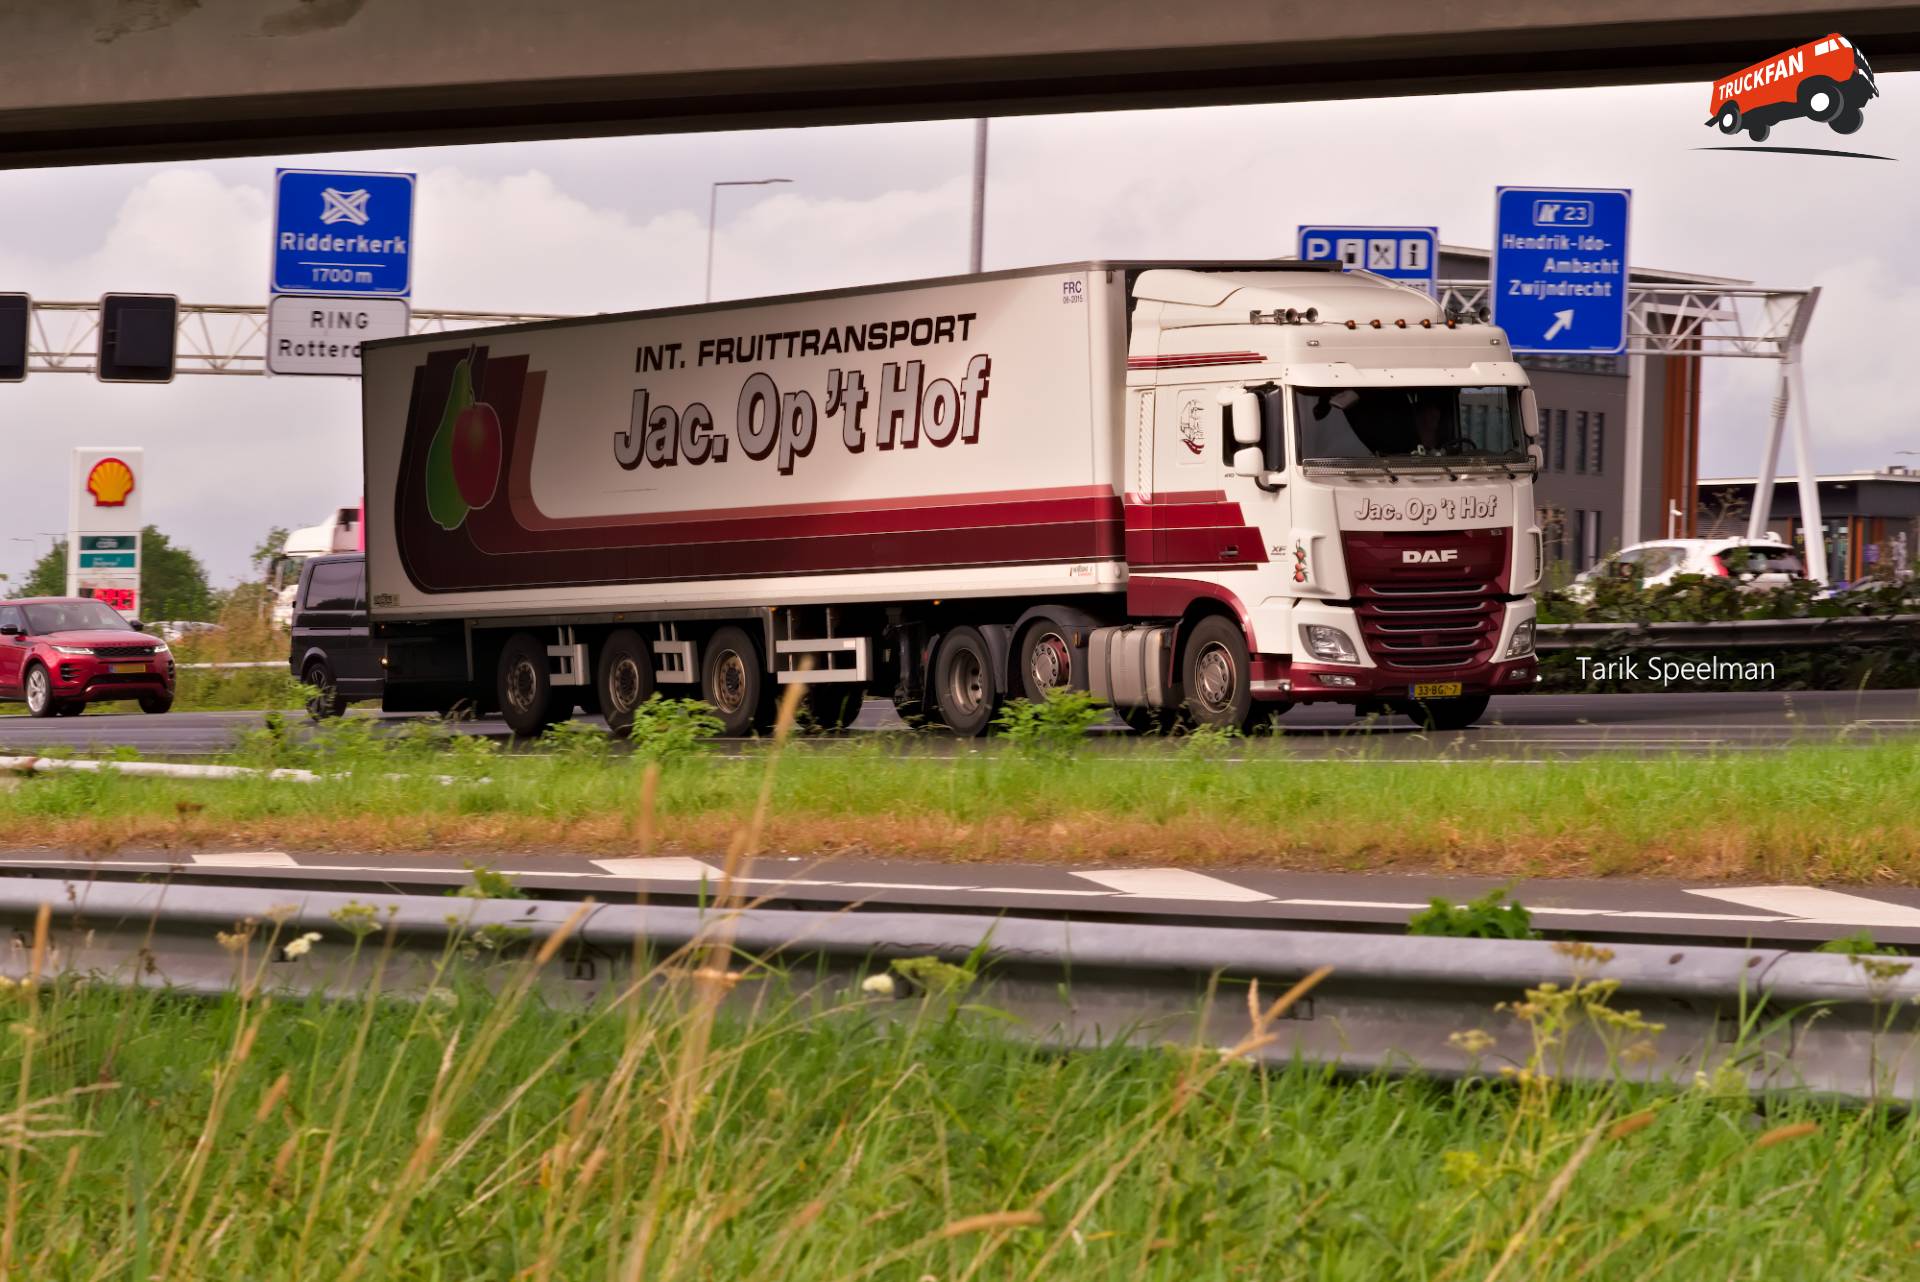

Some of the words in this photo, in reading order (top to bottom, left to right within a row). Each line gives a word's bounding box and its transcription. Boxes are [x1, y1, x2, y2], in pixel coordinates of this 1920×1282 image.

[1563, 206, 1587, 221] 23
[280, 231, 406, 254] Ridderkerk
[1307, 238, 1331, 260] P
[1502, 233, 1612, 251] Hendrik-Ido-
[1543, 257, 1619, 274] Ambacht
[311, 267, 353, 283] 1700
[355, 270, 373, 284] m
[1063, 280, 1082, 294] FRC
[1508, 279, 1612, 300] Zwijndrecht
[310, 310, 369, 329] RING
[635, 343, 686, 373] INT.
[697, 312, 977, 367] FRUITTRANSPORT
[613, 387, 729, 471] Jac.
[736, 372, 817, 476] Op
[876, 353, 992, 451] Hof
[1355, 498, 1403, 521] Jac.
[1405, 497, 1437, 525] Op
[1459, 495, 1498, 519] Hof
[1402, 549, 1458, 564] DAF
[1416, 683, 1459, 697] 33-BG-7
